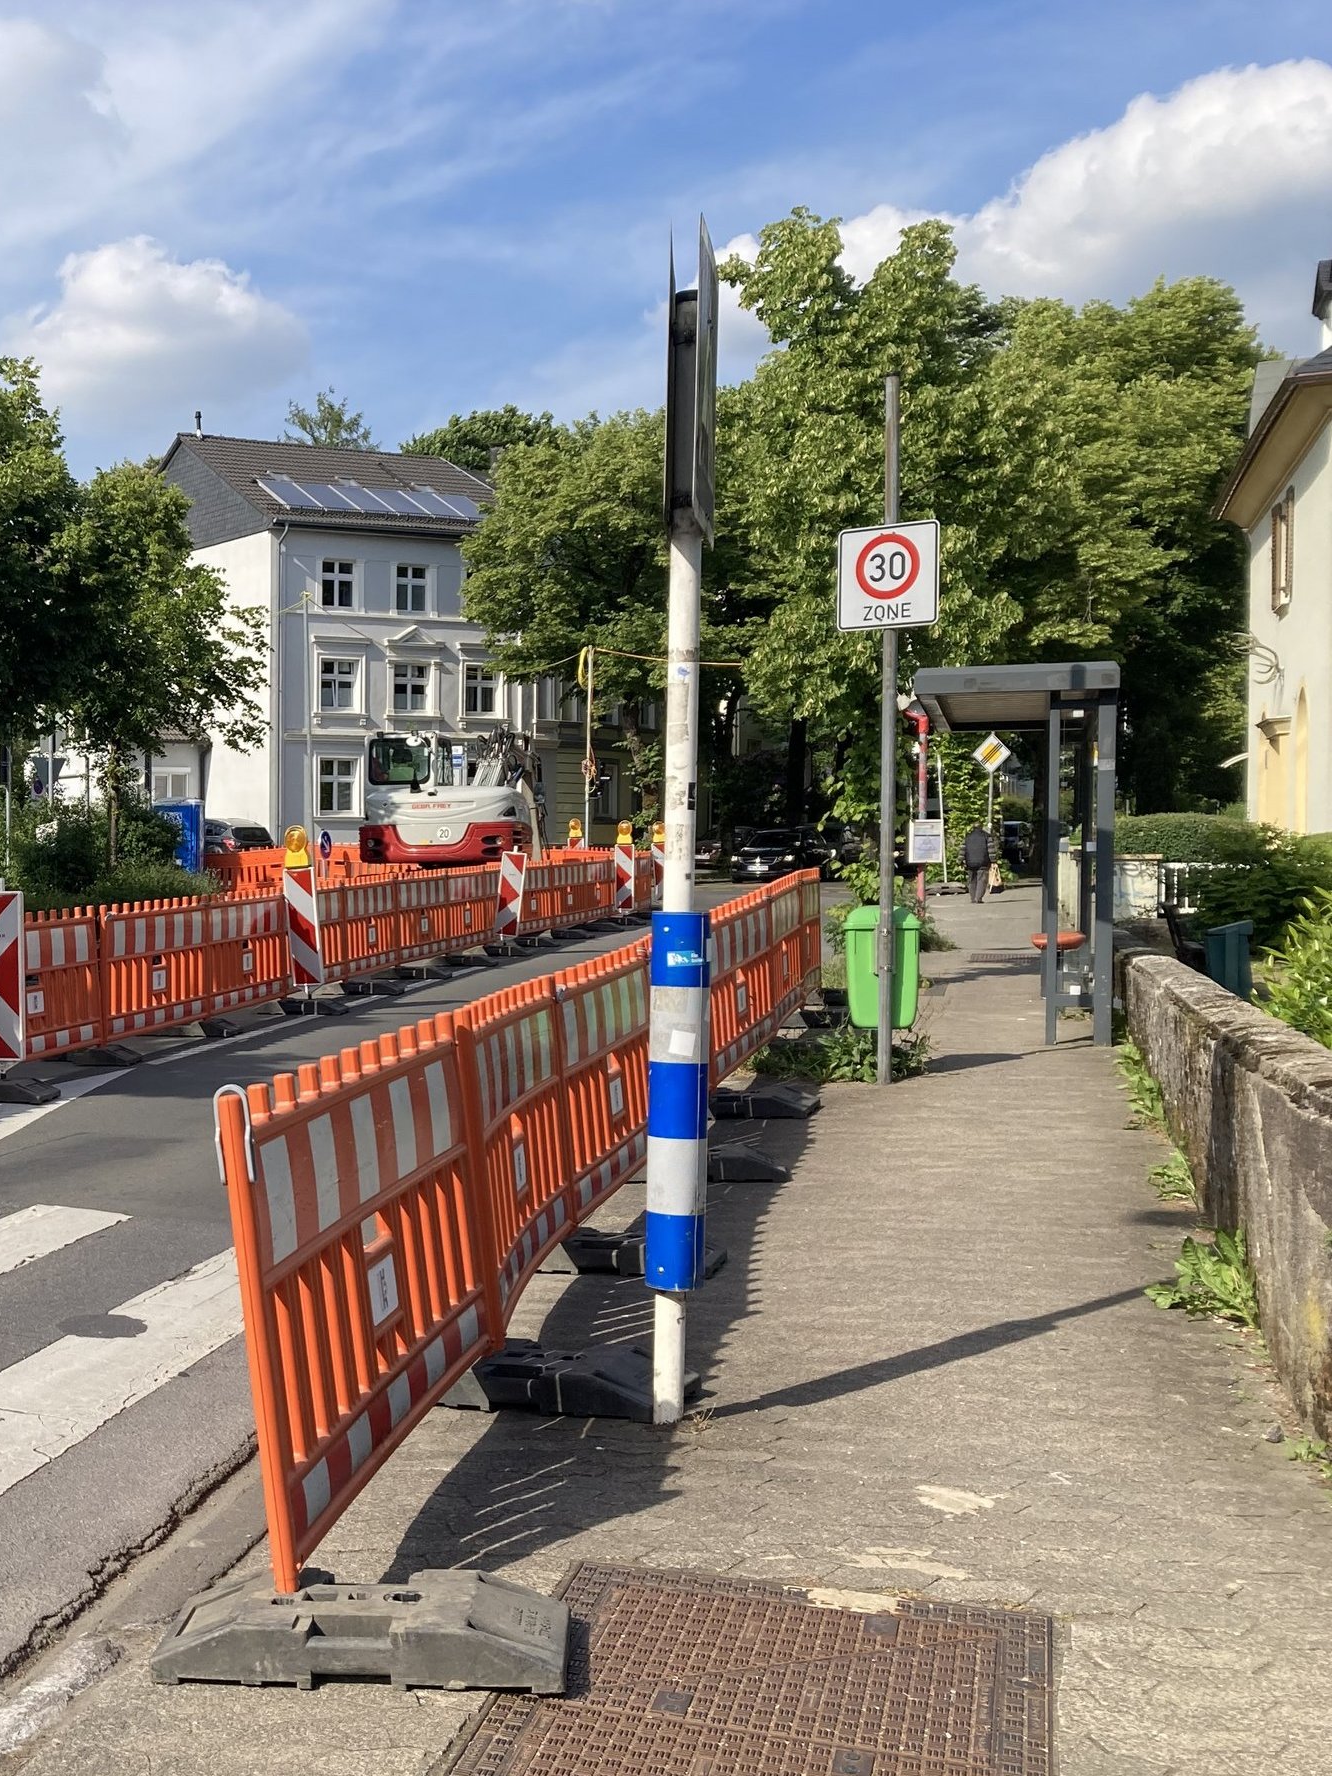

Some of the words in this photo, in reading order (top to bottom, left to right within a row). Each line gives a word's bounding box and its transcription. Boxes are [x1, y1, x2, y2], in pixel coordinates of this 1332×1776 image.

[869, 551, 906, 583] 30
[863, 602, 912, 622] ZONE
[439, 828, 450, 839] 20
